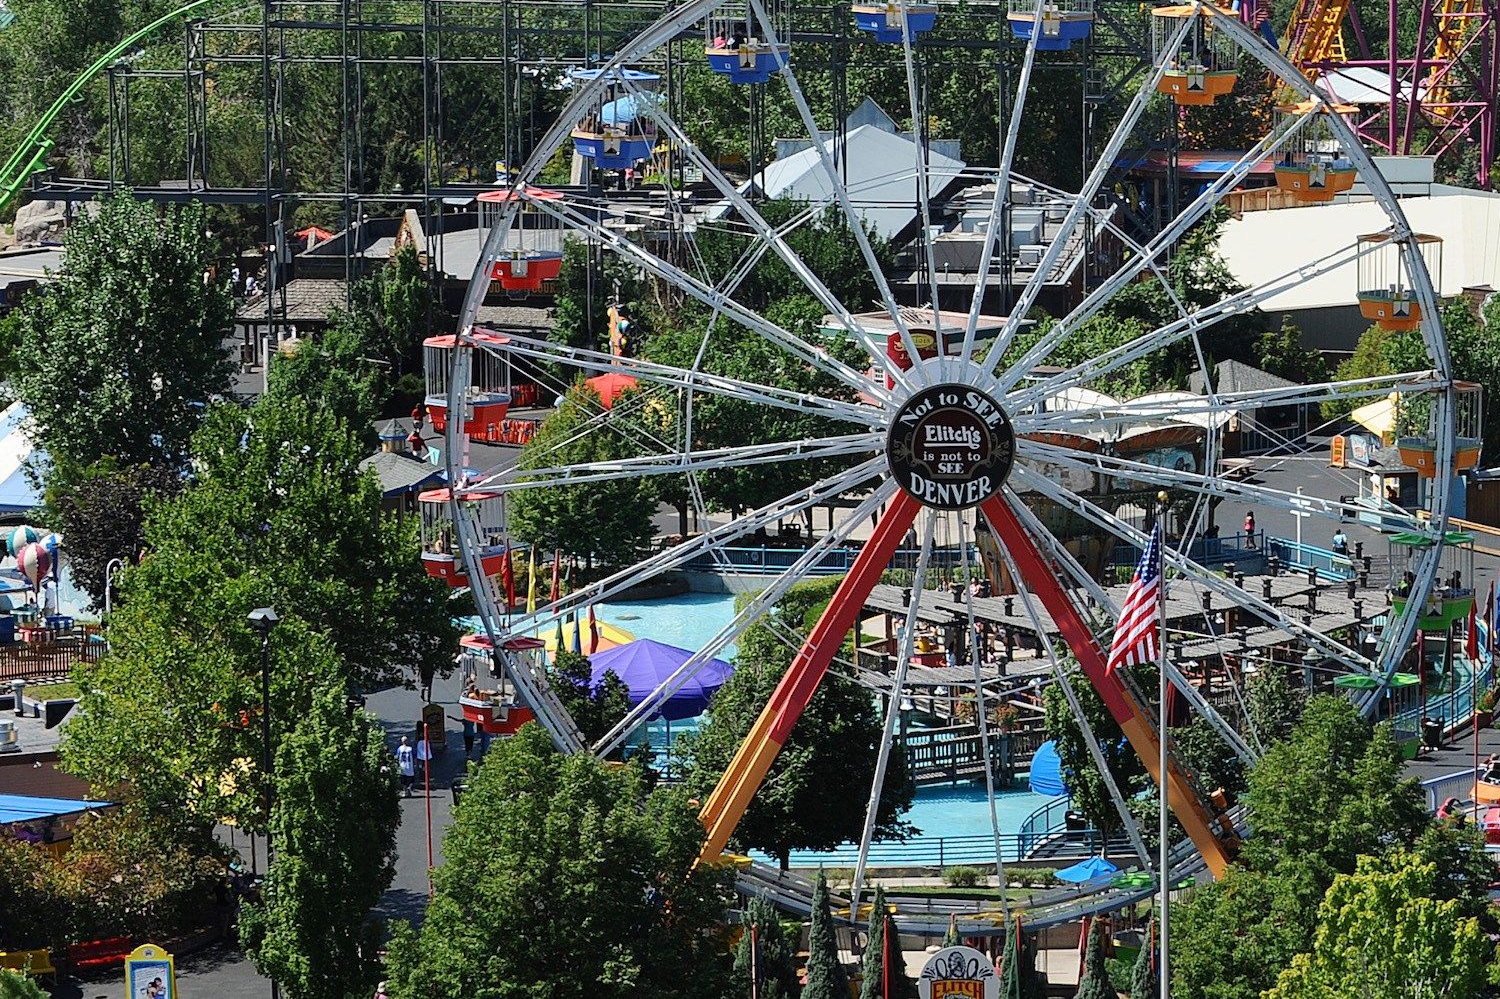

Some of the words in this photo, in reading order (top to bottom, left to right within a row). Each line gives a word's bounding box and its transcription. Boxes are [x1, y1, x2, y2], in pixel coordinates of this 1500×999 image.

[899, 398, 934, 428] Not
[939, 392, 959, 406] to
[963, 392, 1004, 429] SEE
[924, 424, 981, 448] Elitch's
[923, 452, 935, 461] is
[941, 451, 962, 461] not
[968, 452, 981, 461] to
[937, 463, 965, 474] SEE
[910, 472, 992, 505] DENVER
[932, 982, 982, 998] ELITCH
